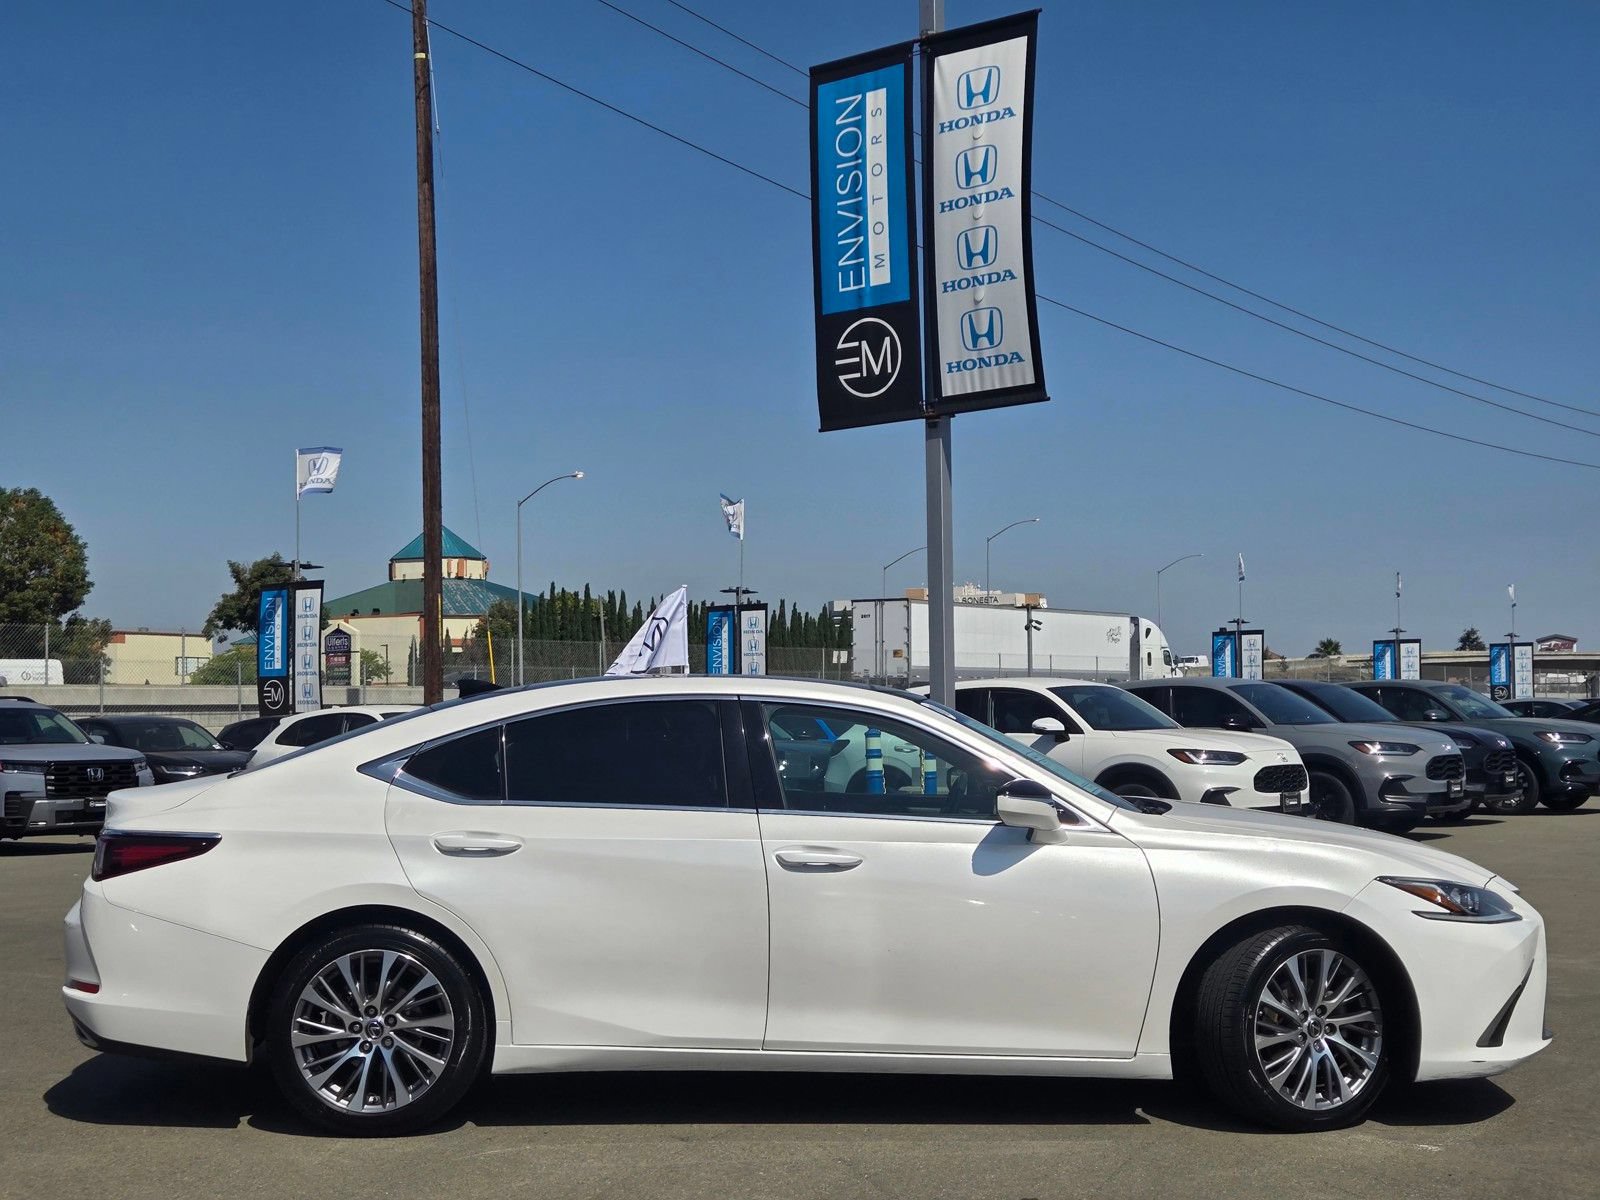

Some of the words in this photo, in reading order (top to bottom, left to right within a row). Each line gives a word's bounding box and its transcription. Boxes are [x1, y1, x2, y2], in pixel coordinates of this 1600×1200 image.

[938, 106, 1017, 135] HONDA
[835, 92, 865, 293] ENVISION
[871, 107, 884, 269] MOTORS
[938, 186, 1015, 214] HONDA
[941, 268, 1018, 294] HONDA
[945, 349, 1026, 374] HONDA
[961, 596, 999, 604] SONESTA
[264, 597, 275, 670] ENVISION
